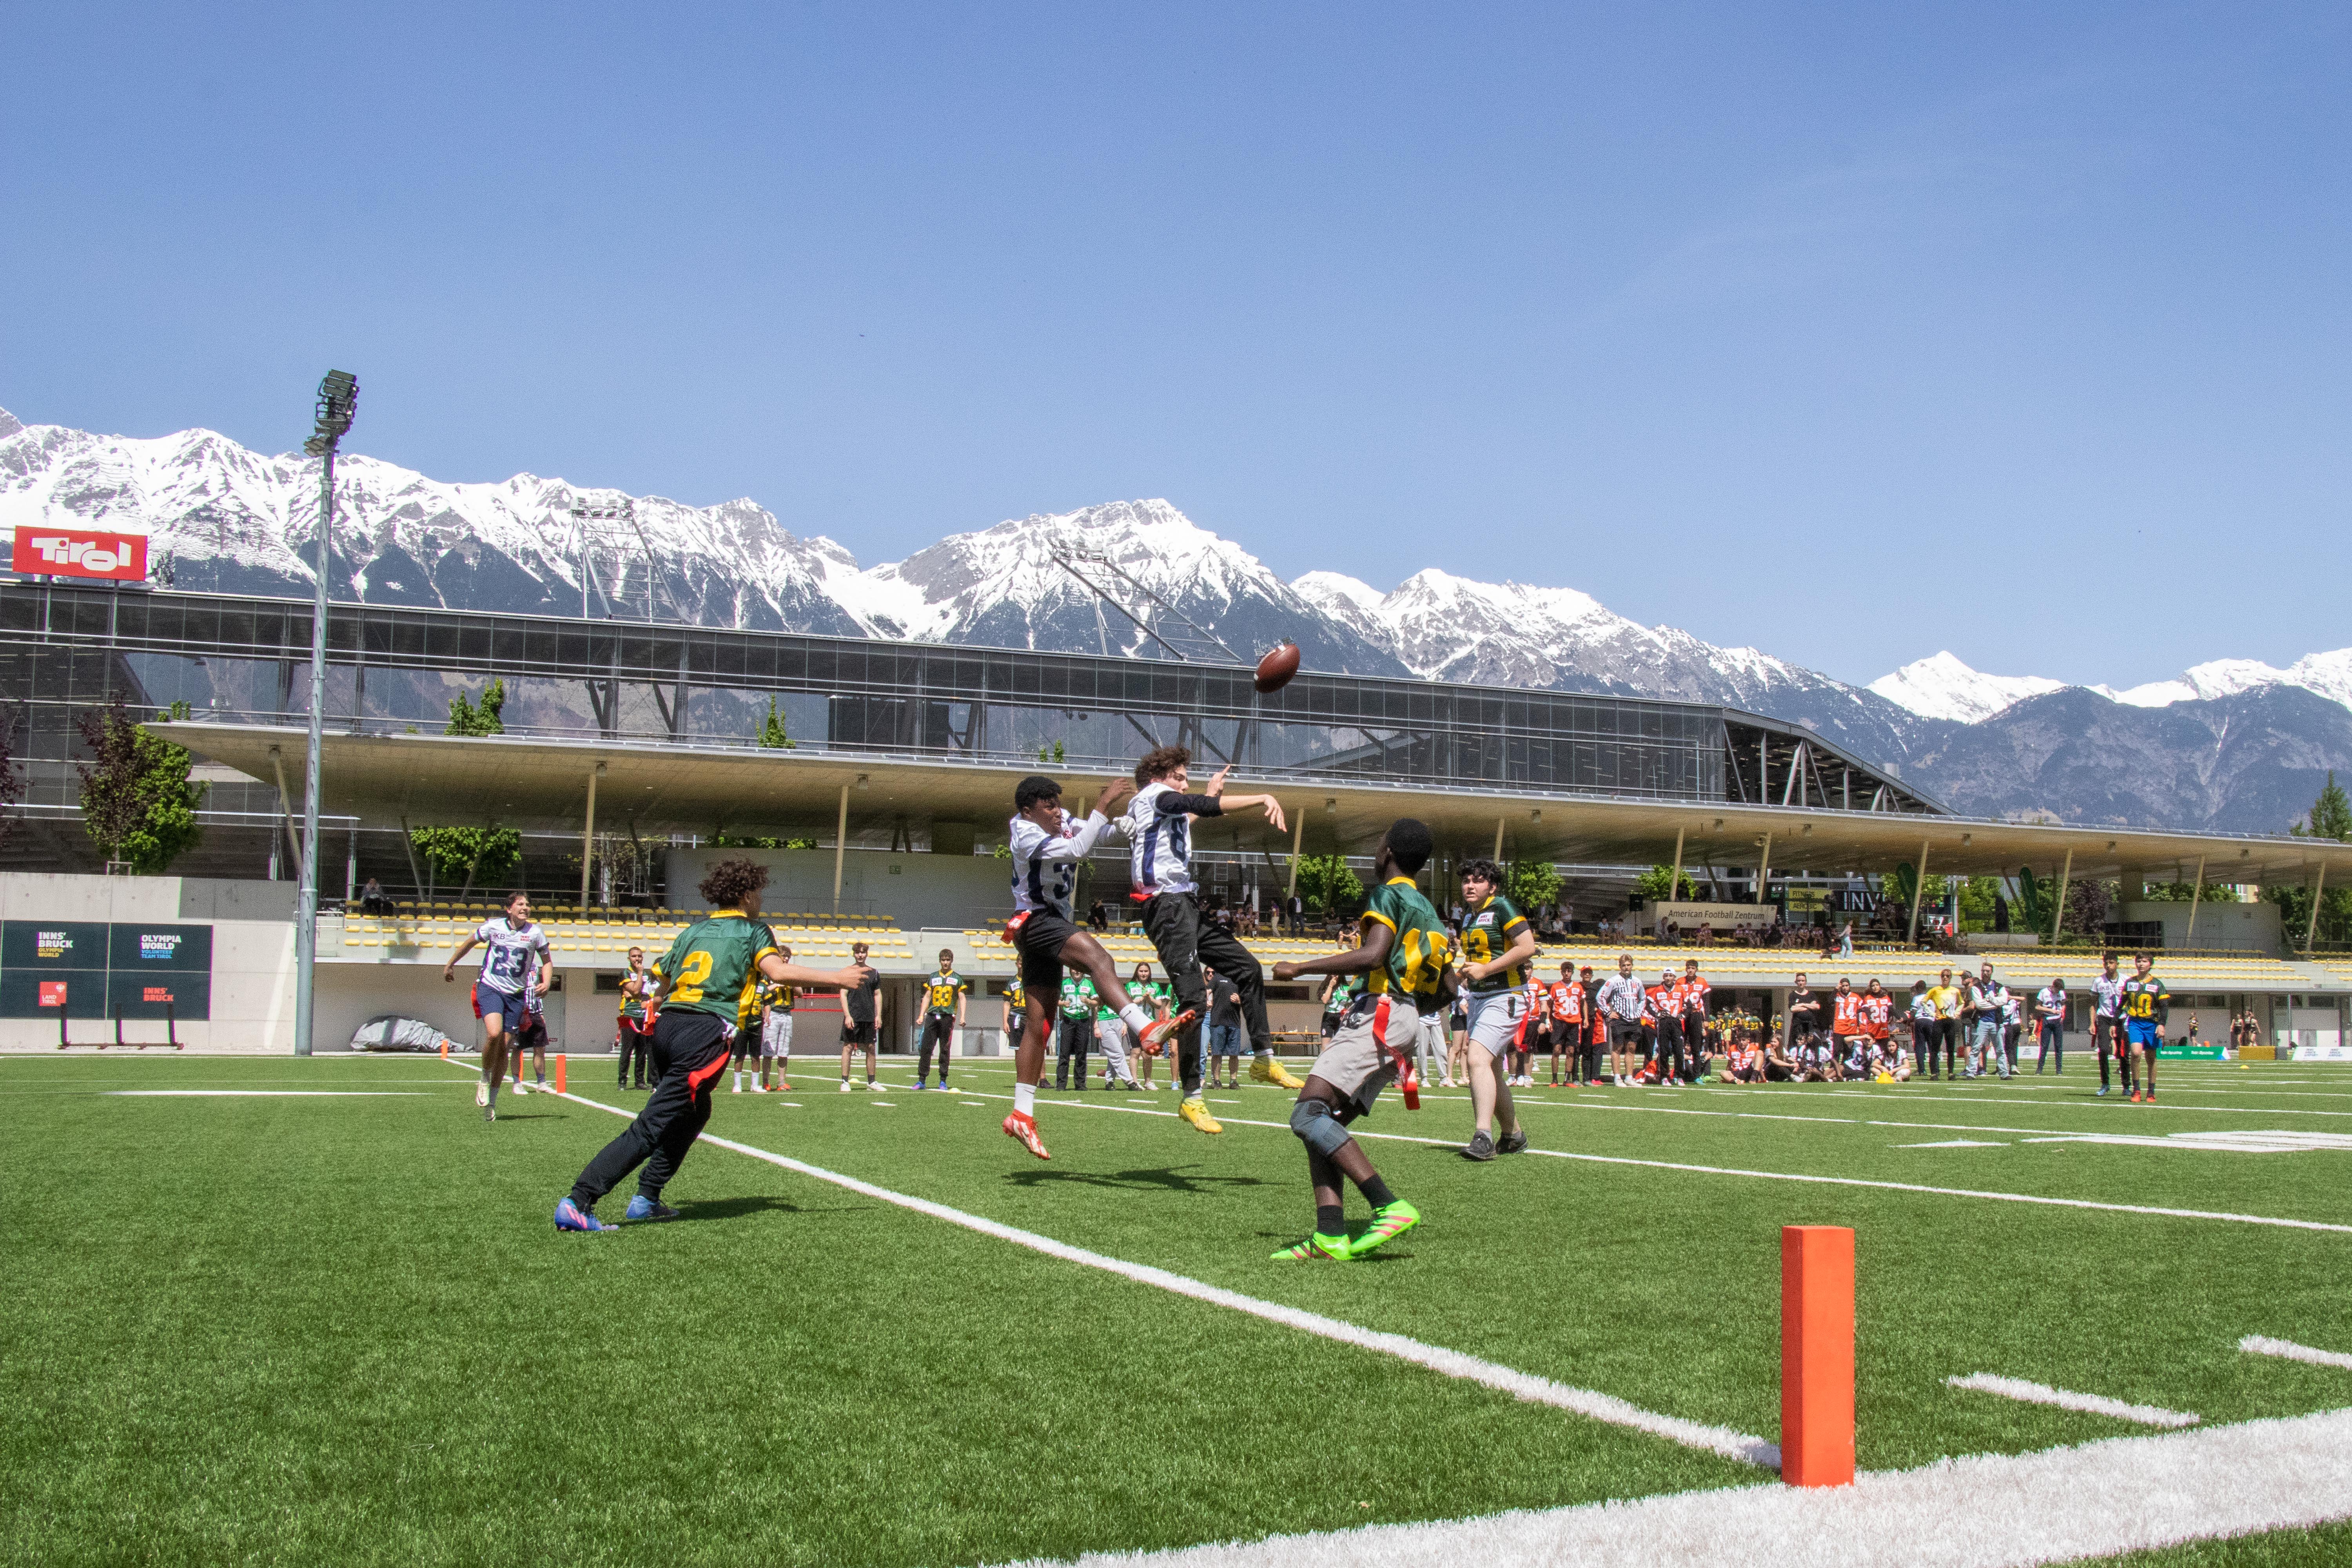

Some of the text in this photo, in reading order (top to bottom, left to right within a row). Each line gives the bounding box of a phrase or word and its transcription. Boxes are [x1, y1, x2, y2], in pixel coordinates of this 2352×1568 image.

[31, 537, 132, 572] Tirol
[1844, 892, 1885, 910] INV
[1668, 909, 1764, 920] American Football Zentrum
[38, 932, 67, 940] INNS'
[141, 935, 182, 943] OLYMPIA
[491, 945, 528, 978] 23
[669, 951, 713, 1003] 2
[1559, 996, 1579, 1015] 36
[1838, 1003, 1857, 1020] 14
[2127, 992, 2152, 1017] 10
[1870, 1005, 1888, 1023] 26
